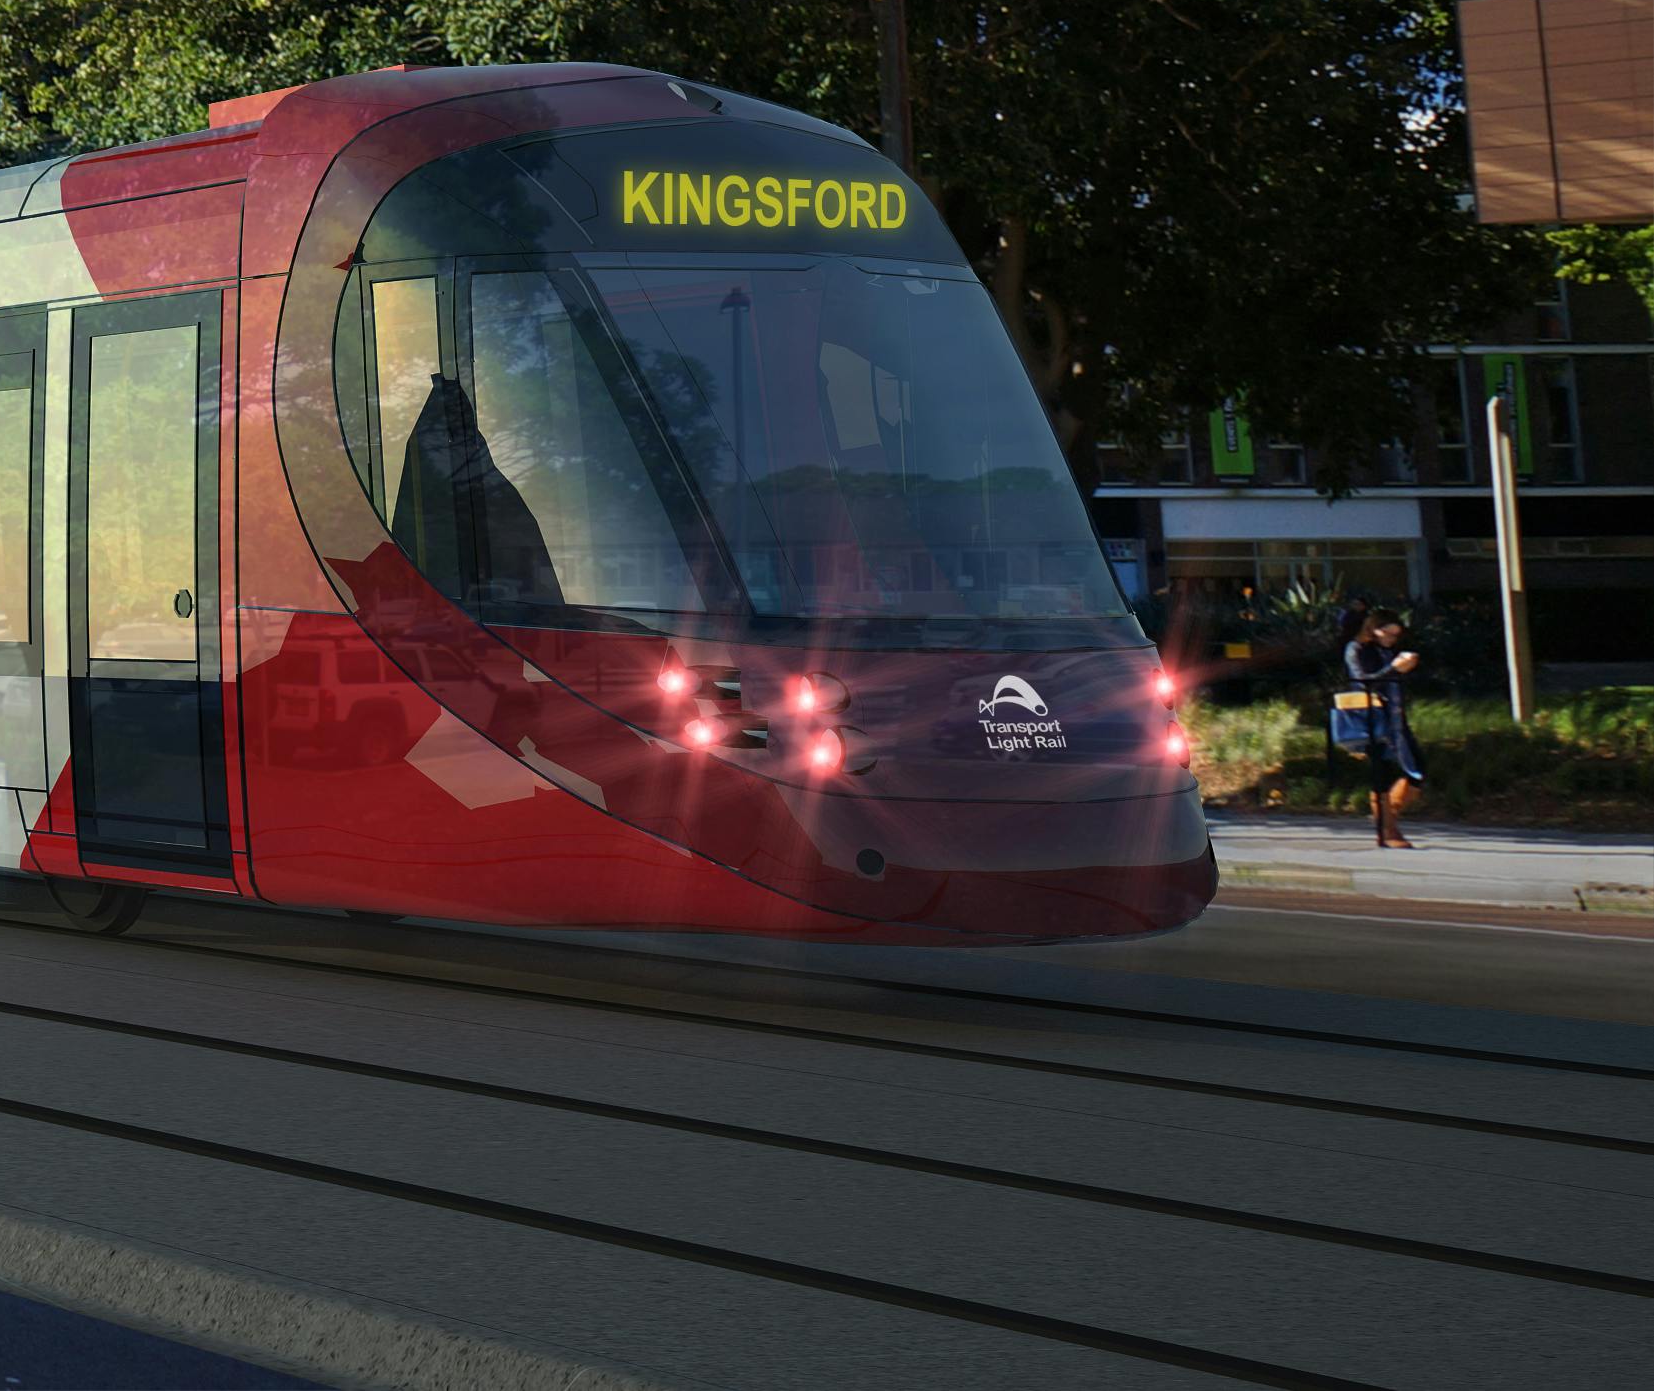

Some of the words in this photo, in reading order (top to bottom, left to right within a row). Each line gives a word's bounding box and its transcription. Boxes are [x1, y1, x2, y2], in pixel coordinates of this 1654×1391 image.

[622, 170, 907, 229] KINGSFORD
[978, 719, 1062, 735] Transport
[987, 736, 1032, 752] Light
[1035, 735, 1067, 749] Rail
